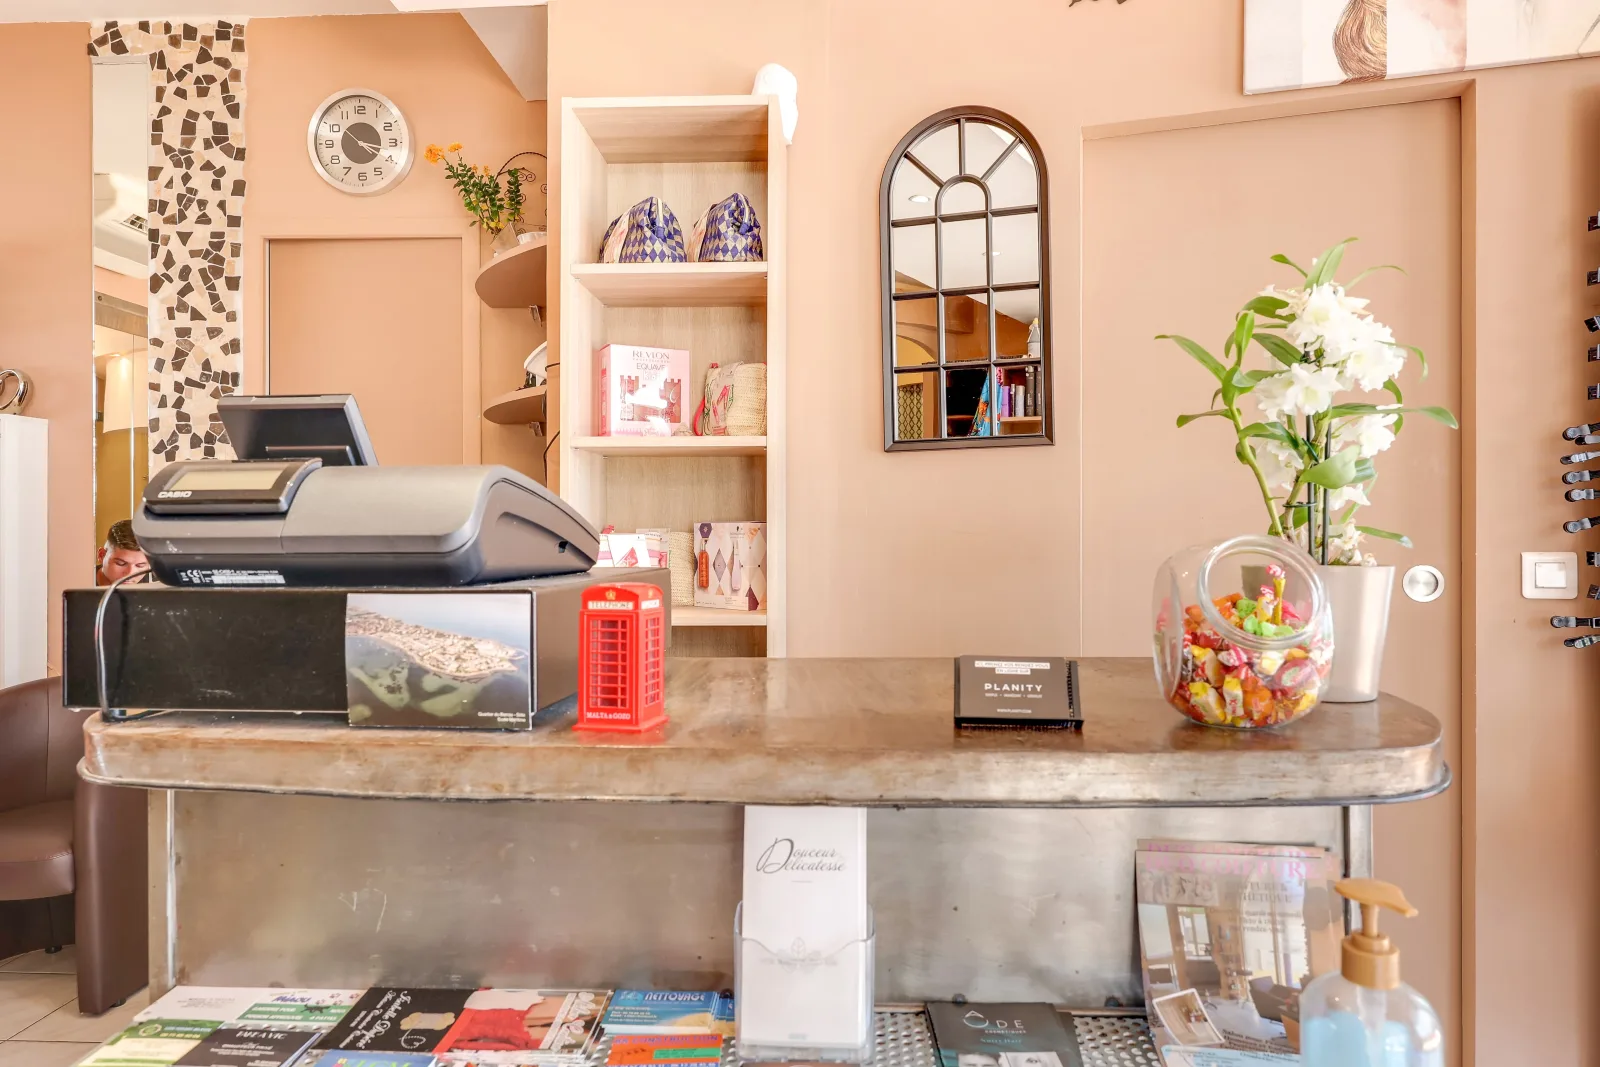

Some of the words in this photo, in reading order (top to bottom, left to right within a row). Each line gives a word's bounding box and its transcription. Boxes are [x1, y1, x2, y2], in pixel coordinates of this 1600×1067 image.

[354, 105, 367, 115] 12
[329, 123, 341, 133] 10
[383, 122, 393, 132] 2
[325, 139, 335, 149] 9
[388, 138, 398, 148] 3
[330, 155, 341, 165] 8
[385, 154, 395, 164] 4
[342, 166, 352, 176] 7
[373, 167, 383, 176] 5
[357, 172, 368, 182] 6
[632, 350, 670, 360] REVLON
[636, 362, 666, 371] EQUAVE
[157, 490, 193, 499] CASIO
[591, 601, 630, 609] TELEPHONE
[984, 683, 1043, 692] PLANITY
[586, 711, 608, 720] MALTA
